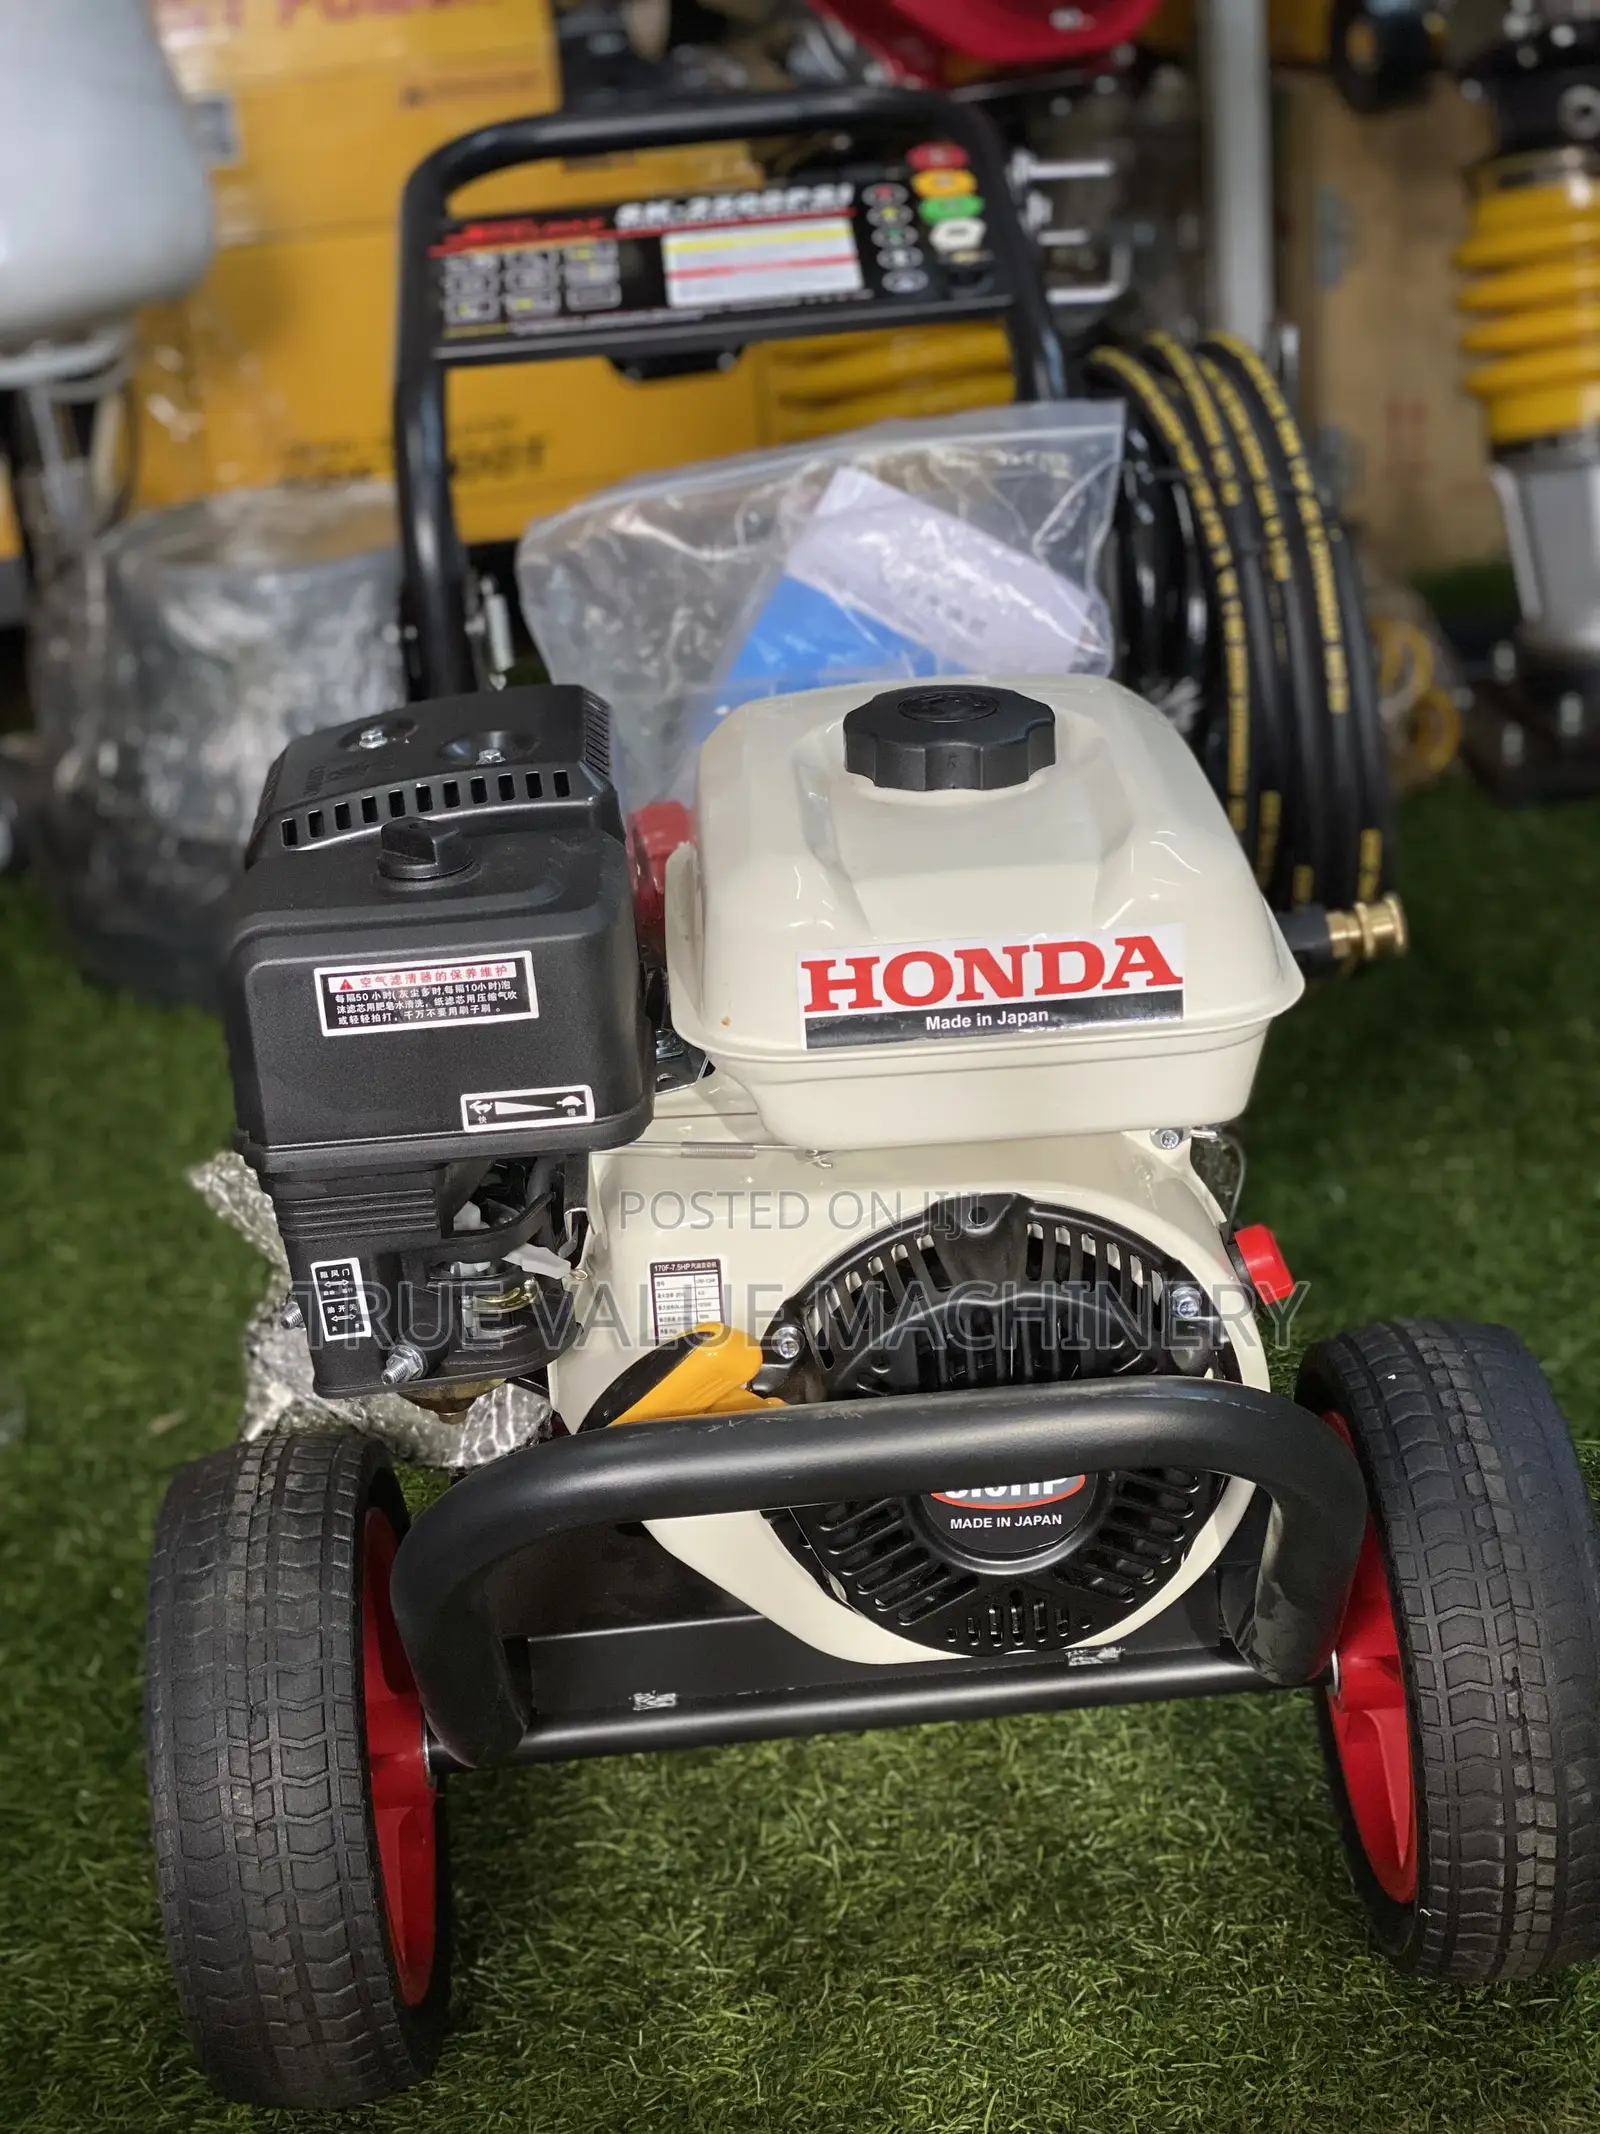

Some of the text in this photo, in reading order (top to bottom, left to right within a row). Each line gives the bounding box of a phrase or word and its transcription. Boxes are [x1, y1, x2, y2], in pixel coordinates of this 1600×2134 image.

[360, 965, 508, 988] 空气滤清器的保养维护
[801, 935, 1183, 1013] HONDA
[926, 1009, 1049, 1031] Made in Japan
[950, 1514, 1063, 1530] MADE IN JAPAN
